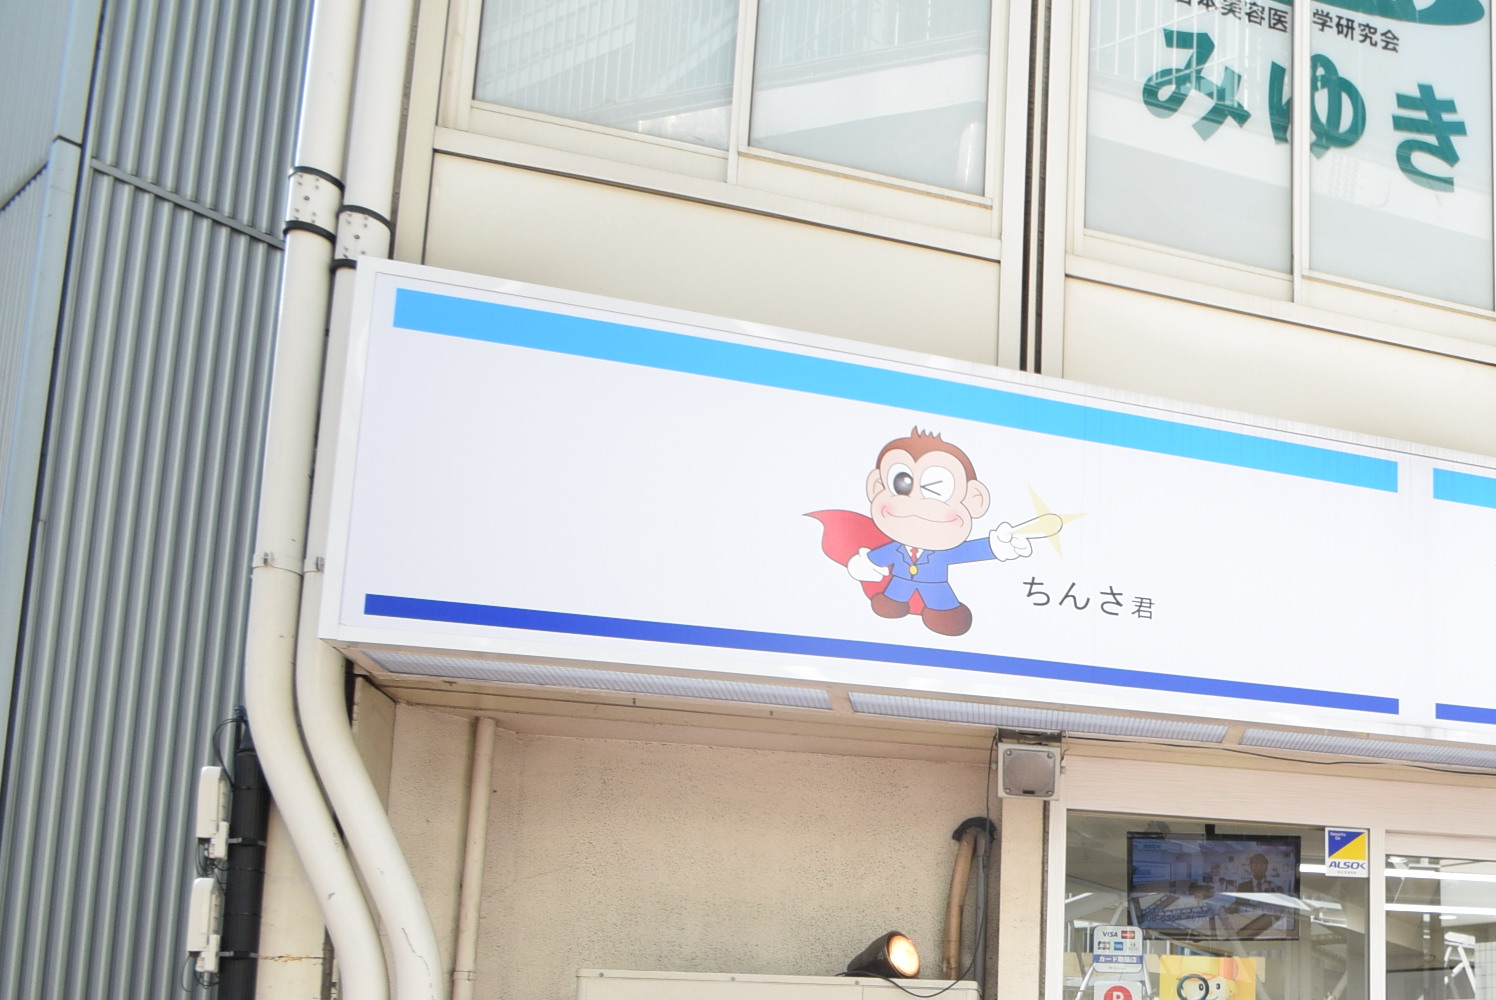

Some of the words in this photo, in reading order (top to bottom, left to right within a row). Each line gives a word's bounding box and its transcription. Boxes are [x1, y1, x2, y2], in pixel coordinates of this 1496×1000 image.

[1142, 28, 1468, 193] みゆき
[1022, 576, 1156, 621] ちんさ君
[1329, 861, 1366, 870] ALSOK
